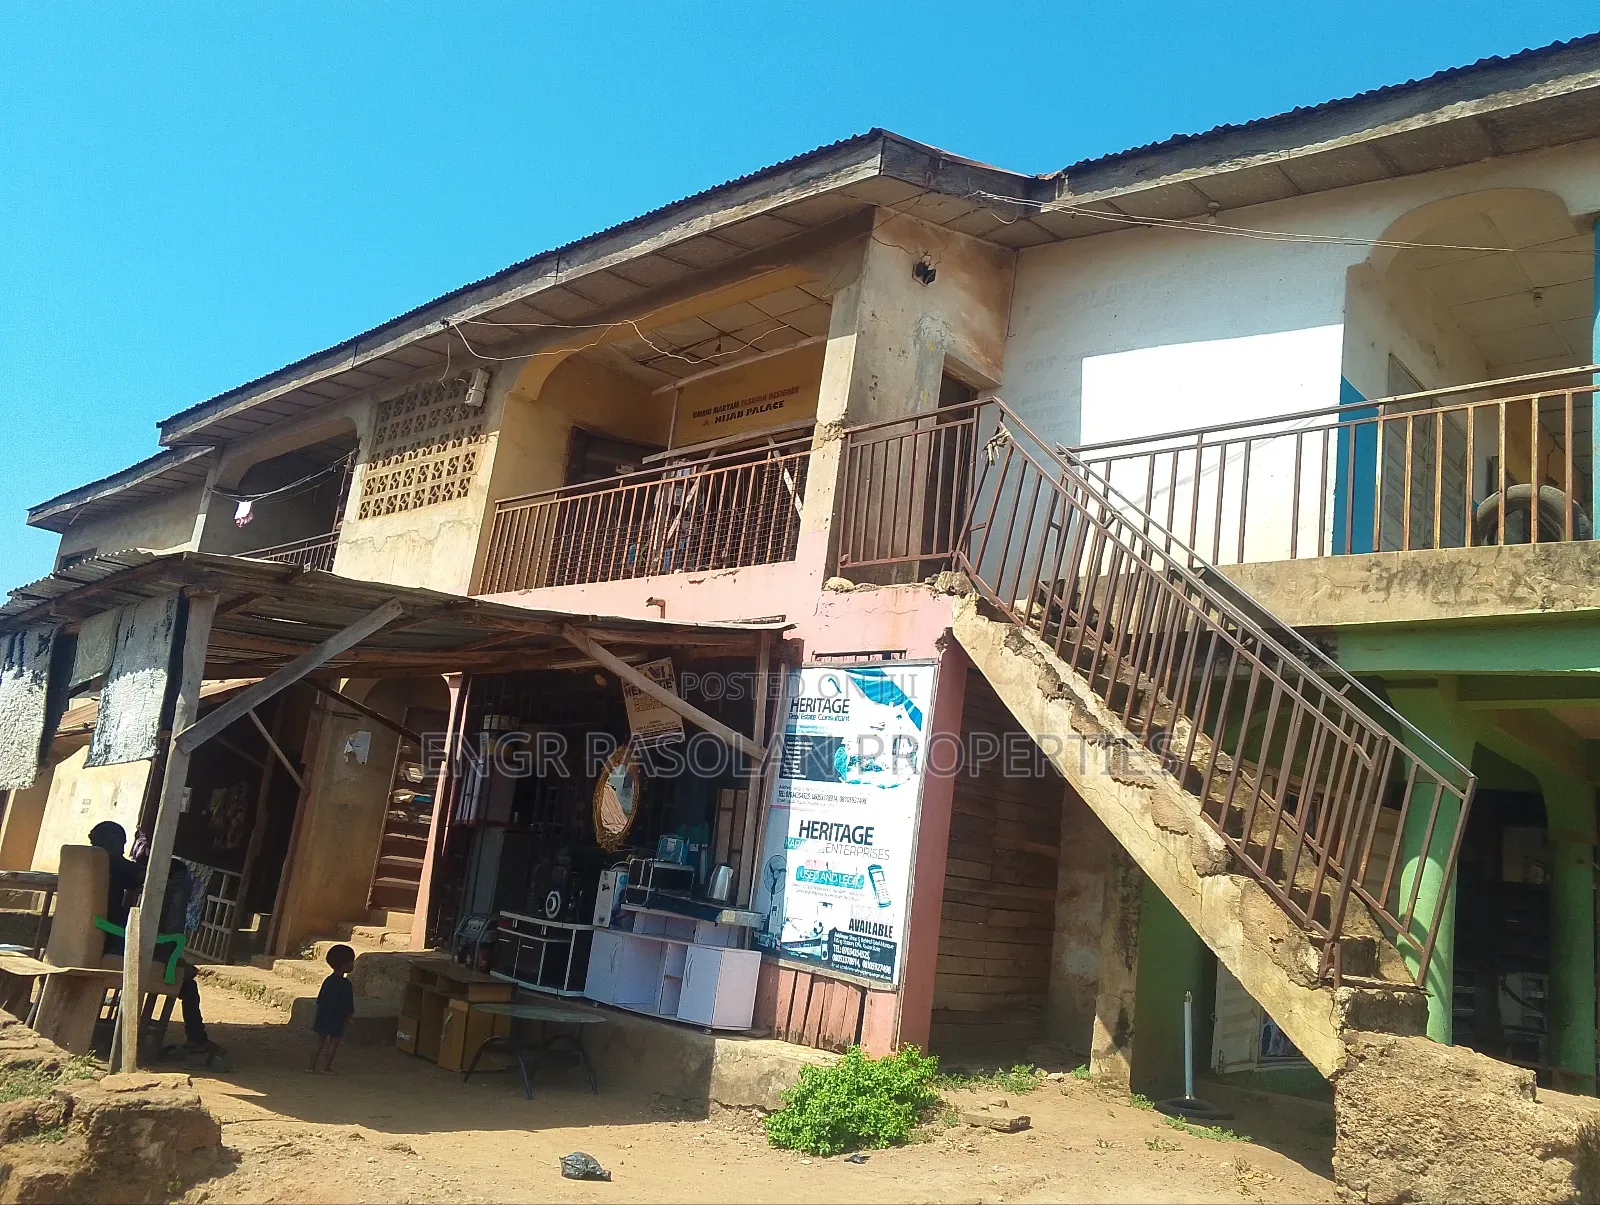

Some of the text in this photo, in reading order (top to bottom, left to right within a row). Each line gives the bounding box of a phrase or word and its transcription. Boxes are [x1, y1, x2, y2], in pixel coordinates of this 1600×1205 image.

[713, 401, 740, 414] MARYAM
[740, 393, 768, 407] FASHION
[768, 386, 800, 401] DESIGNER
[714, 410, 744, 424] HIJAB
[745, 400, 785, 416] PALACE
[790, 698, 851, 714] HERITAGE
[801, 713, 817, 721] Estate
[818, 713, 850, 722] Consultant
[798, 819, 875, 846] HERITAGE
[825, 842, 890, 861] ENTERPRISES
[801, 869, 820, 880] USED
[820, 870, 839, 882] AND
[848, 918, 894, 939] AVAILABLE
